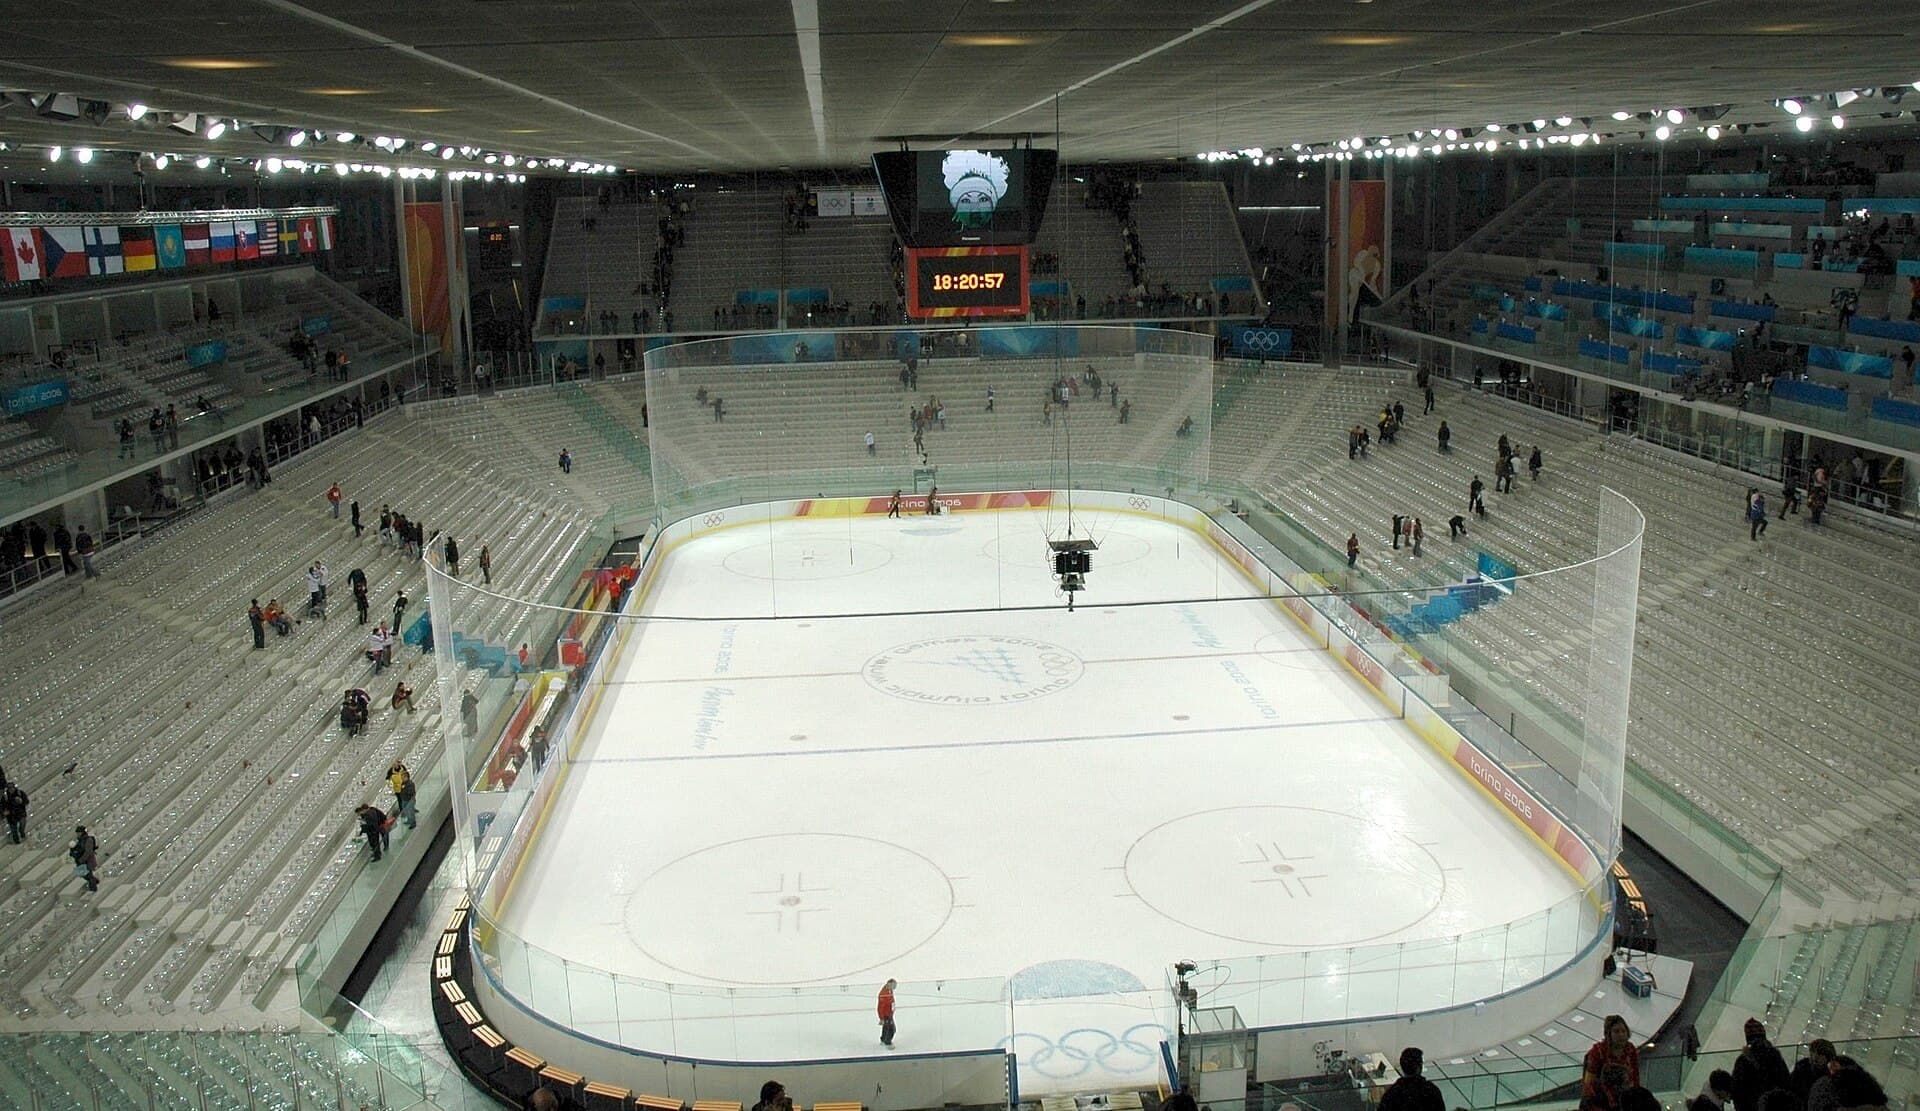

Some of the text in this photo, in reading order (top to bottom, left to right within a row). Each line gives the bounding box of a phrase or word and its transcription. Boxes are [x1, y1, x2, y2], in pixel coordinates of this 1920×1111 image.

[933, 273, 1004, 290] 18:20:57
[887, 499, 926, 509] trino
[1470, 756, 1532, 819] torino 2006
